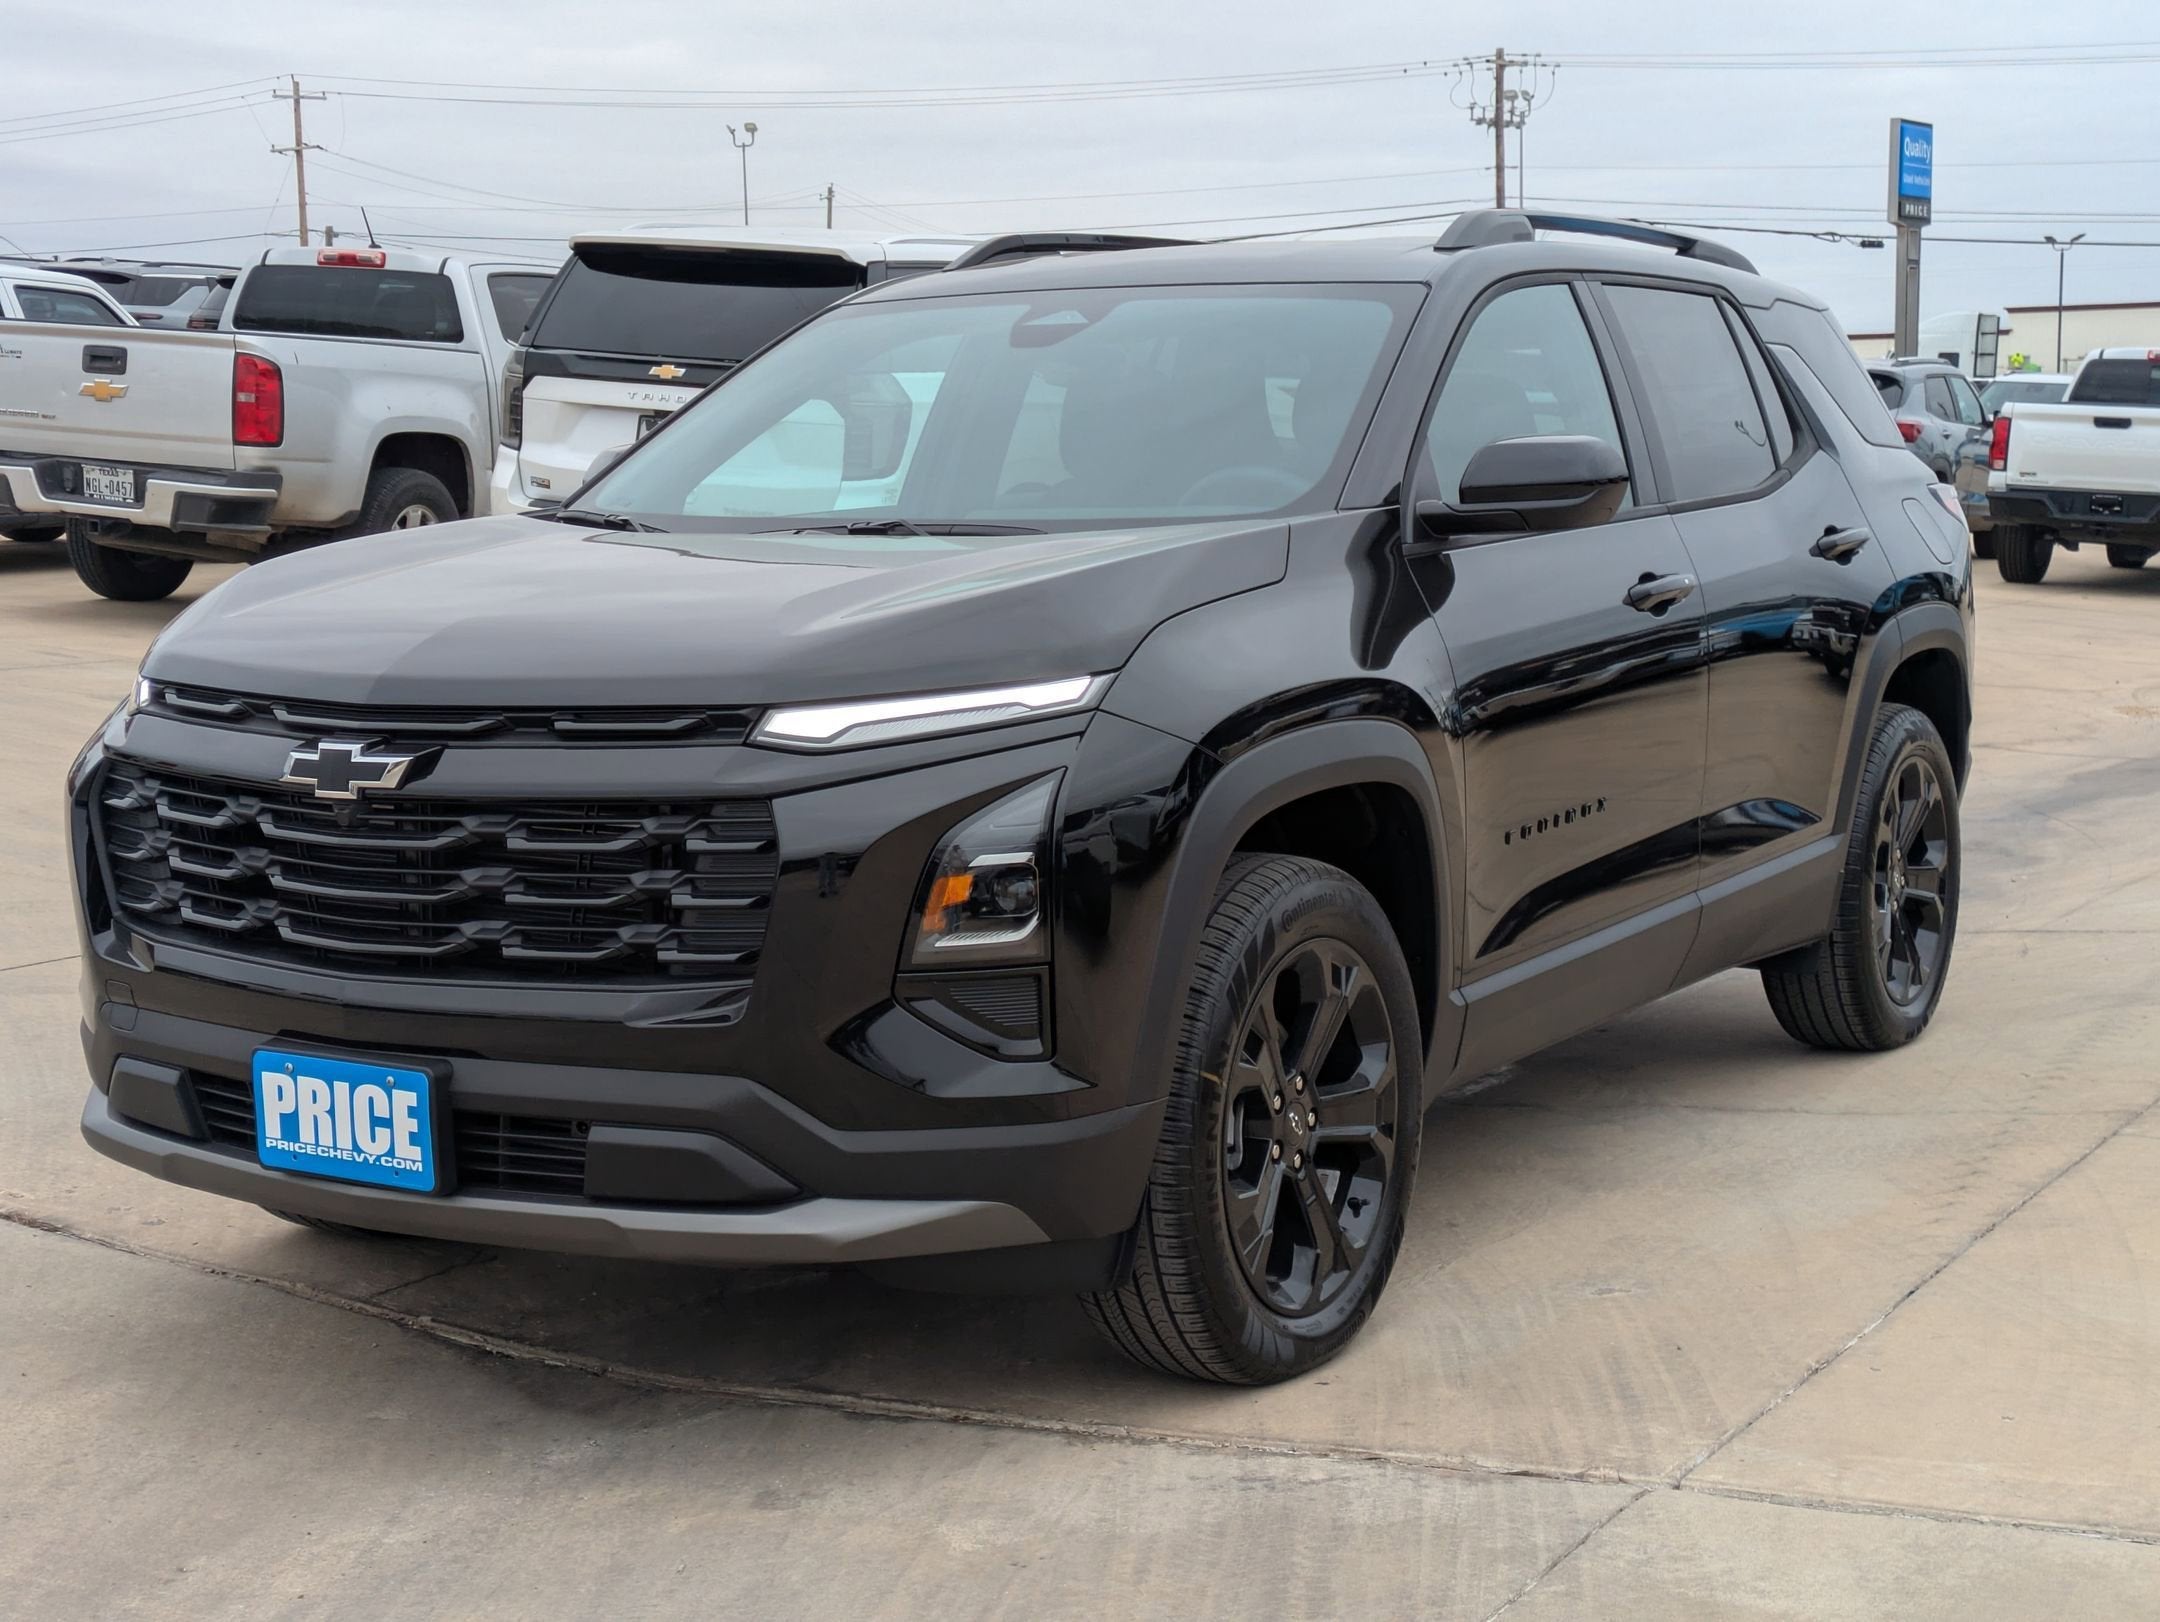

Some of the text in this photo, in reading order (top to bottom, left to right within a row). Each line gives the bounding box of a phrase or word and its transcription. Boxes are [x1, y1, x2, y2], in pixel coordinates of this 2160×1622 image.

[1904, 136, 1931, 164] Quality
[1905, 203, 1928, 217] PRICE
[627, 391, 687, 404] TAHO
[261, 1071, 422, 1161] PRICE
[265, 1138, 423, 1172] PRICECHEVY.COM
